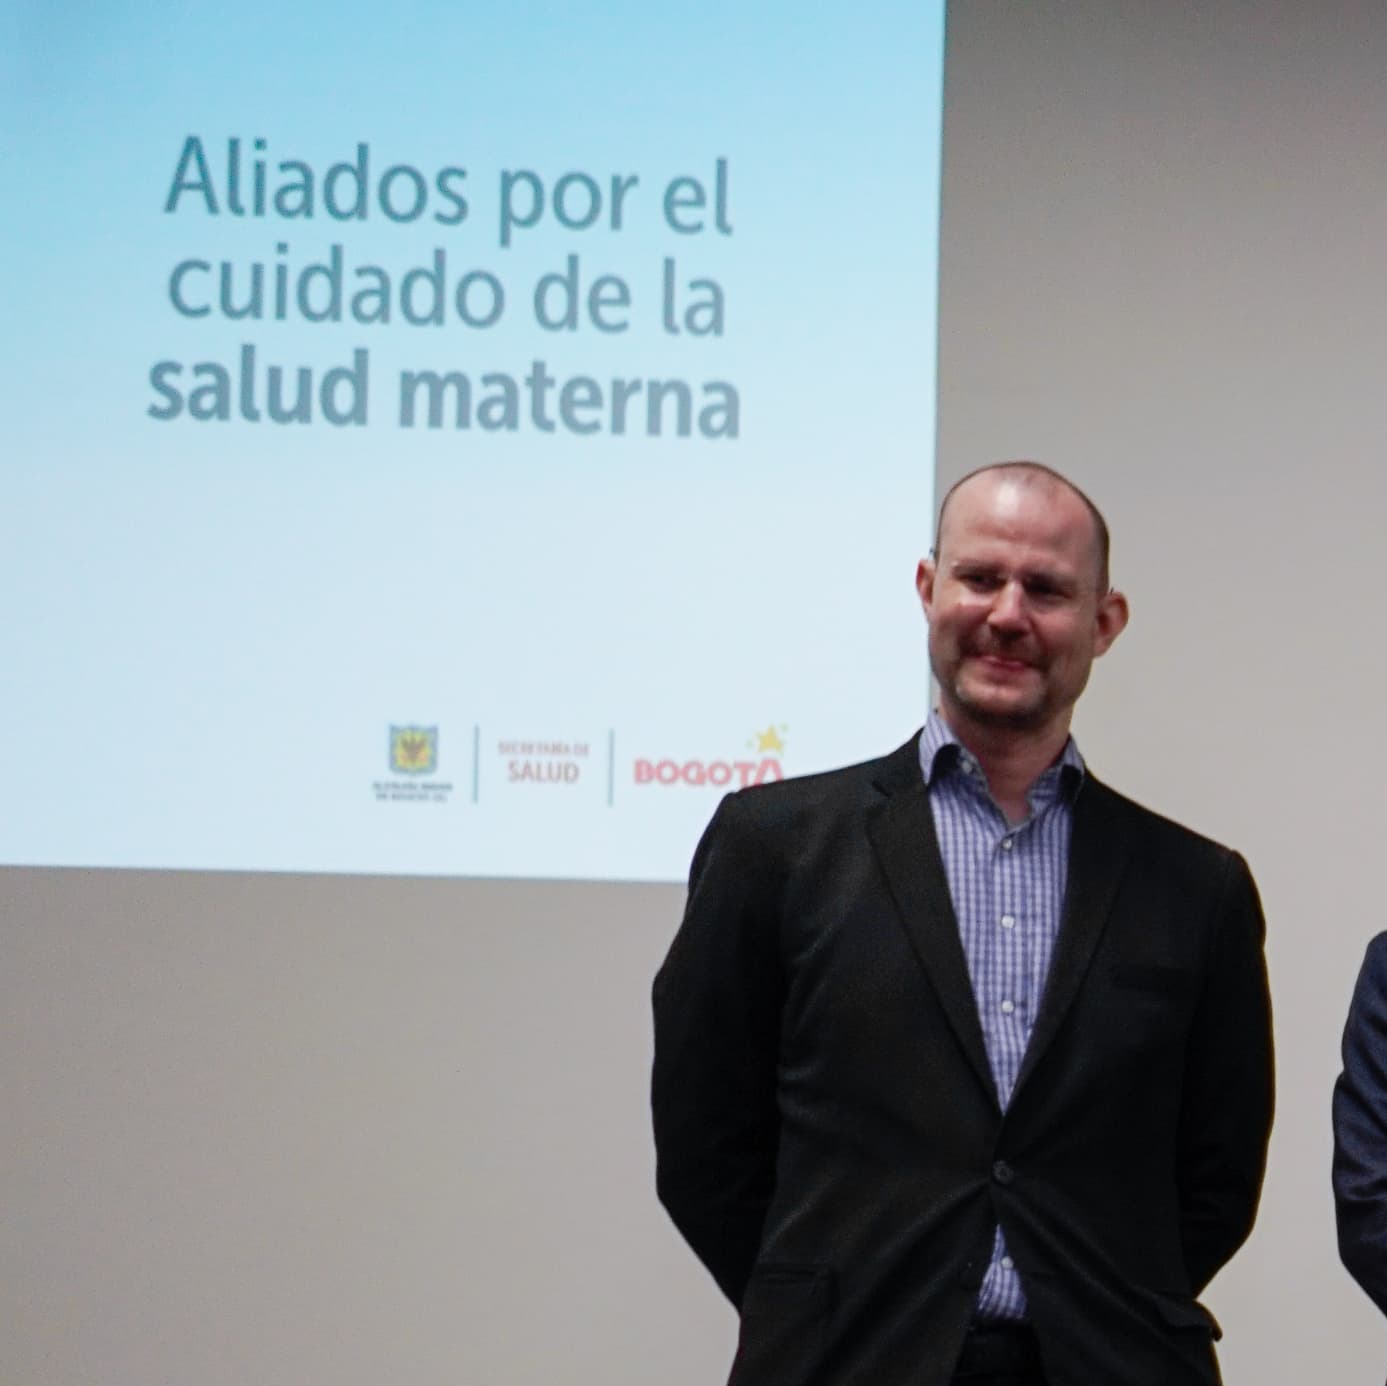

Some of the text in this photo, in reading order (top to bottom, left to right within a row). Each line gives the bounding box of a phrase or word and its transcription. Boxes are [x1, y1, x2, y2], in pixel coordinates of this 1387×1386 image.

[163, 135, 734, 249] Aliados por el
[168, 242, 727, 337] cuidado de la
[146, 343, 742, 440] salud materna
[507, 759, 580, 785] SALUD
